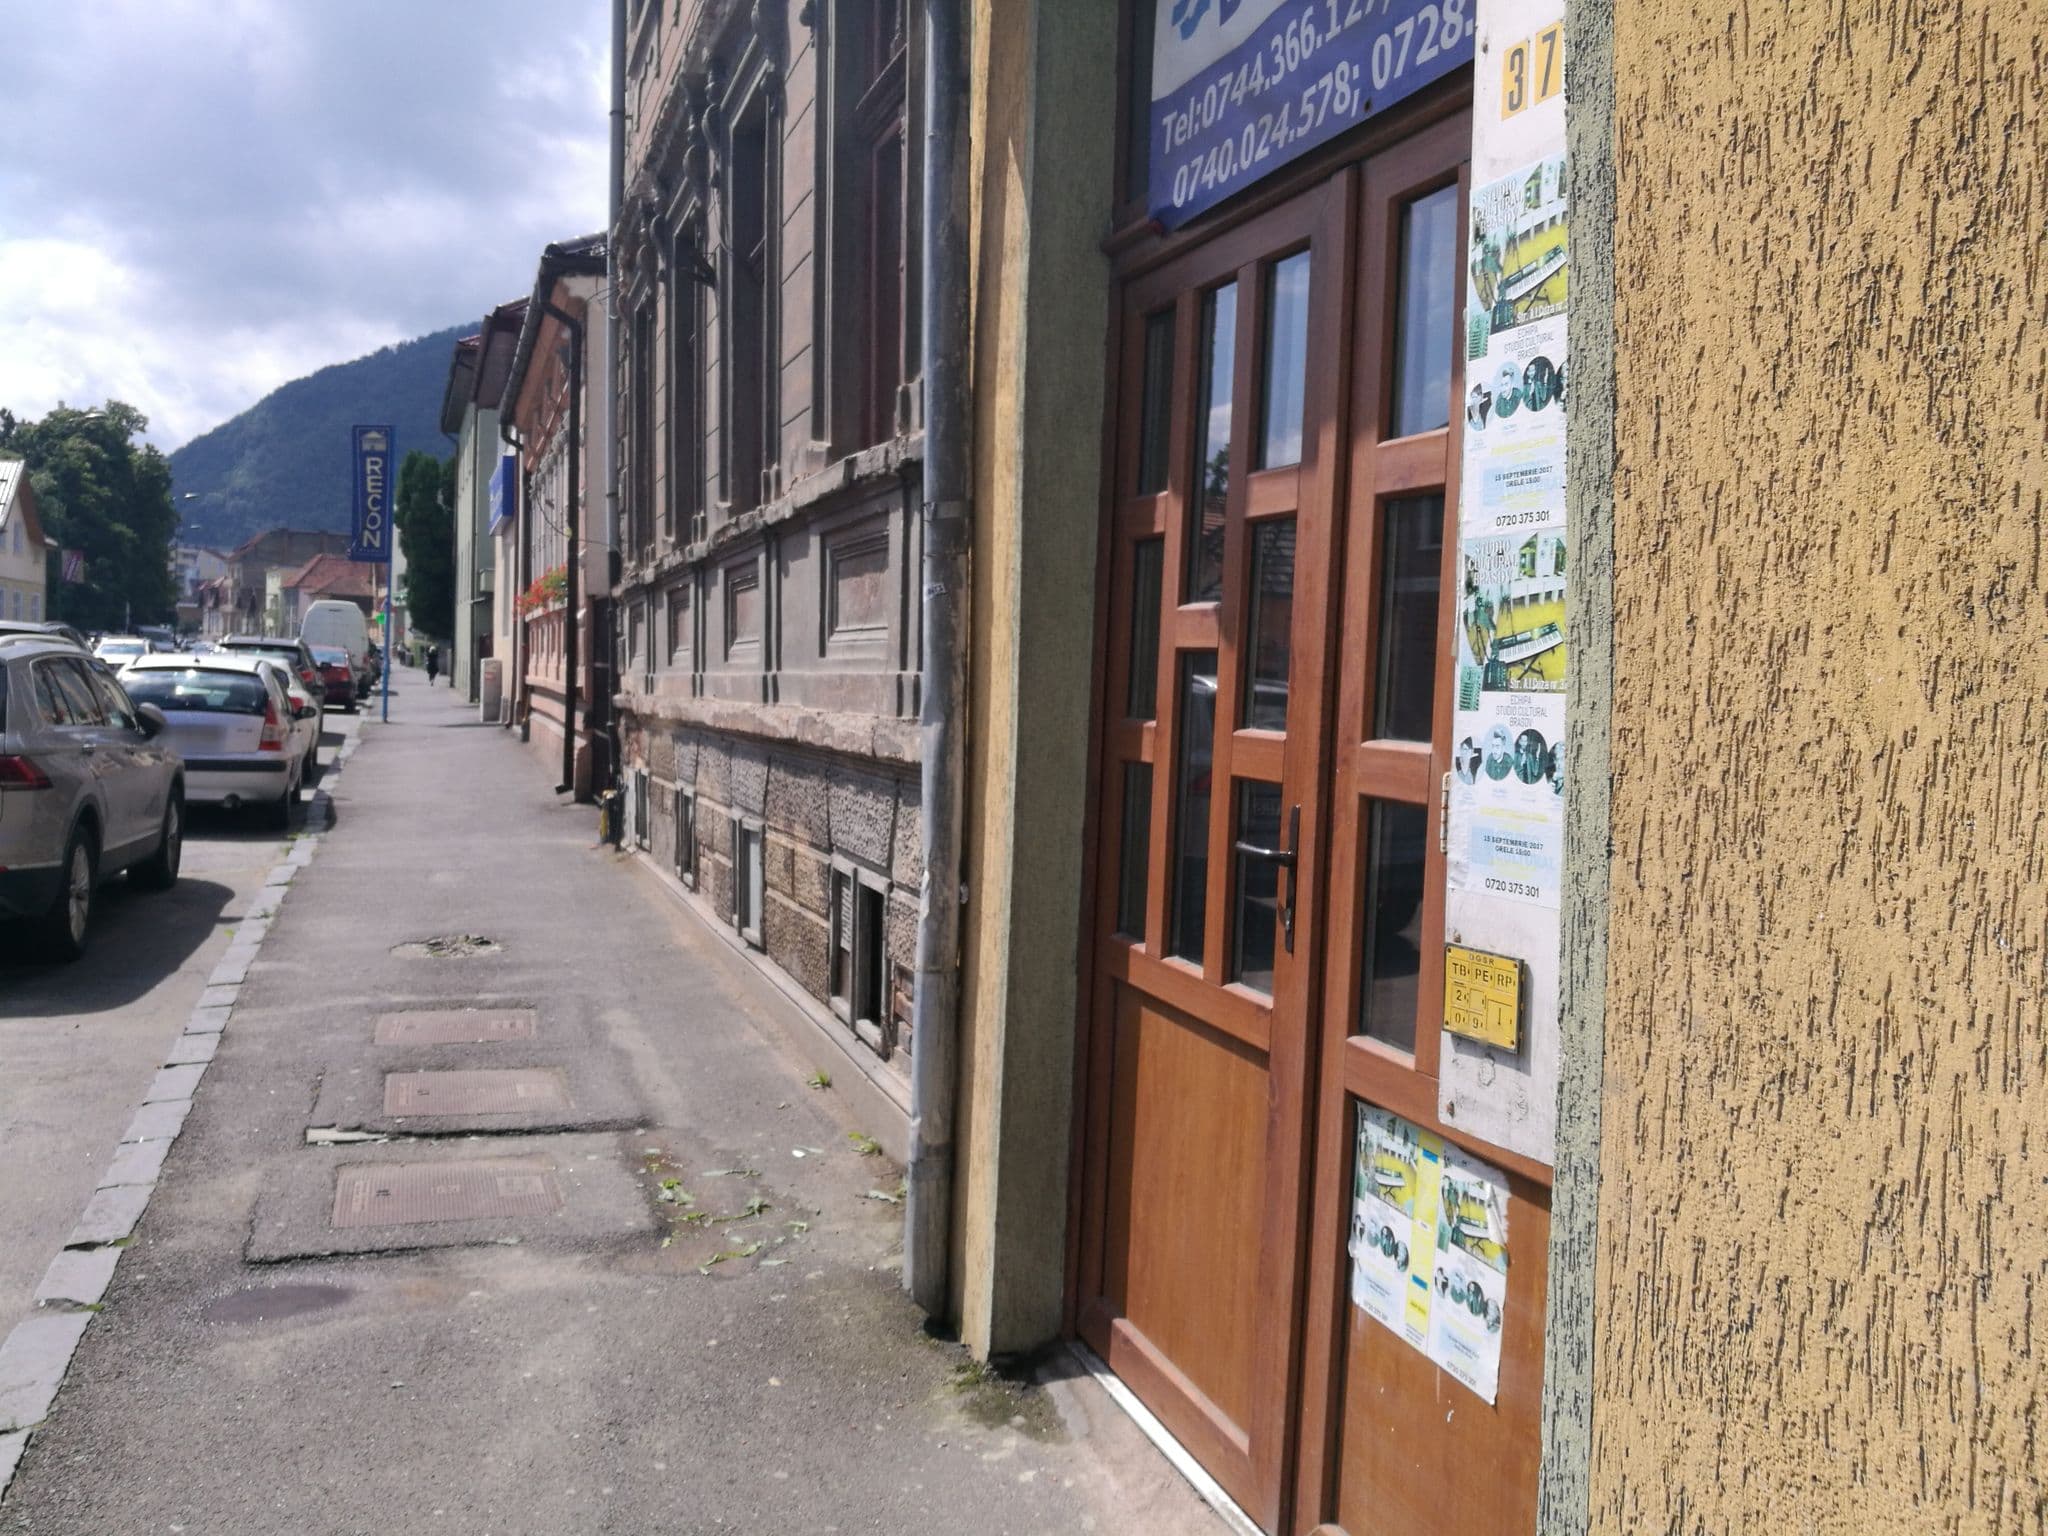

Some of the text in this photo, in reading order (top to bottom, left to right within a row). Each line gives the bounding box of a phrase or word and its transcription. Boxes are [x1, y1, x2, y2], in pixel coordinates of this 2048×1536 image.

[1173, 61, 1360, 208] 0740.024.578;
[362, 457, 383, 548] RECON
[1495, 510, 1550, 527] 0720 375 301
[1485, 878, 1540, 899] 0720 375 301
